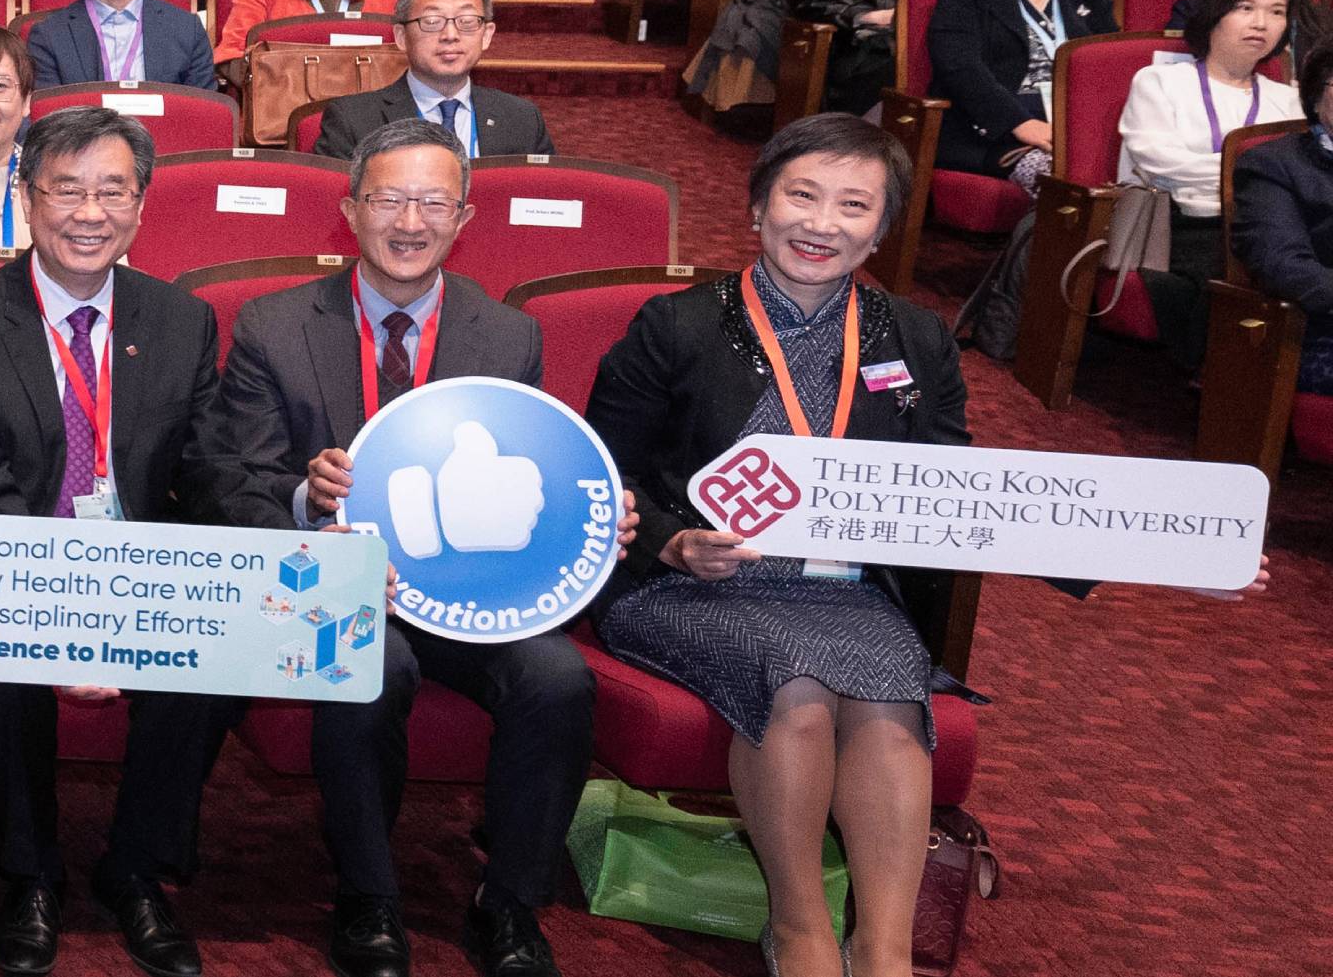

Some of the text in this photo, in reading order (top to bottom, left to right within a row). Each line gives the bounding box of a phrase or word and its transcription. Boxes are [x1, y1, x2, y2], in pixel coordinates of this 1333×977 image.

[812, 458, 1096, 498] THE HONG KONG
[811, 486, 1254, 538] POLYTECHNIC UNIVERSITY
[807, 516, 995, 550] 香港理工大學
[64, 540, 222, 568] Conference
[231, 554, 264, 570] on
[13, 570, 100, 595] Health
[110, 575, 175, 599] Care
[185, 580, 240, 603] with
[136, 610, 225, 636] Efforts:
[66, 643, 94, 662] to
[102, 642, 198, 670] Impact
